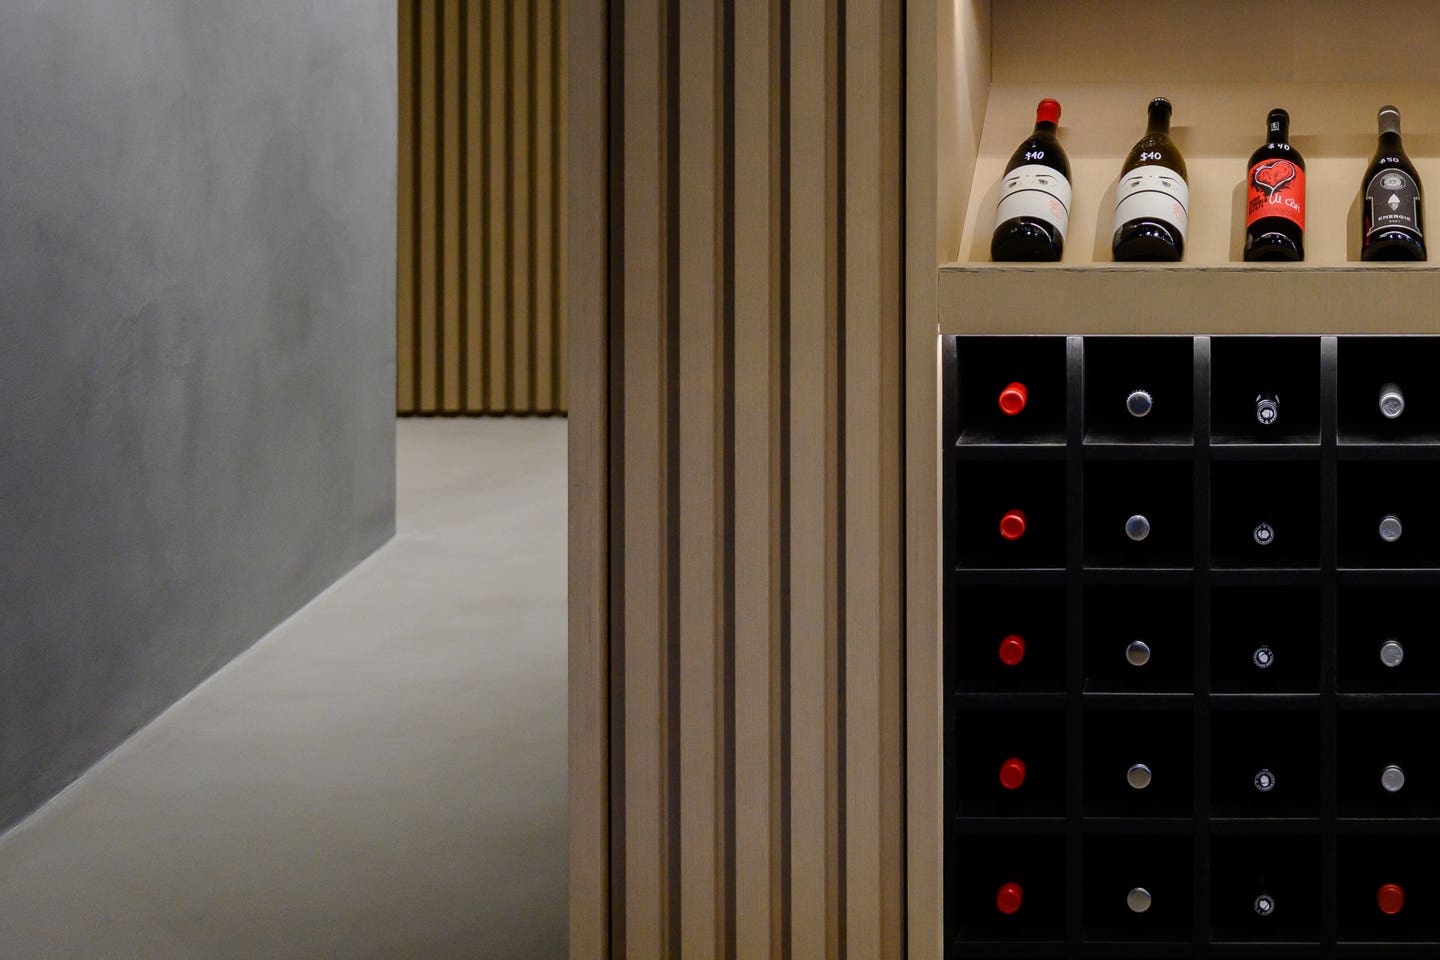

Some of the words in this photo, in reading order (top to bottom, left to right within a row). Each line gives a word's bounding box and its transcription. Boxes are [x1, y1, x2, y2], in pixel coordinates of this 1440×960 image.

[1025, 151, 1045, 161] $40
[1140, 152, 1162, 161] $40
[1378, 214, 1411, 222] ENERGIE
